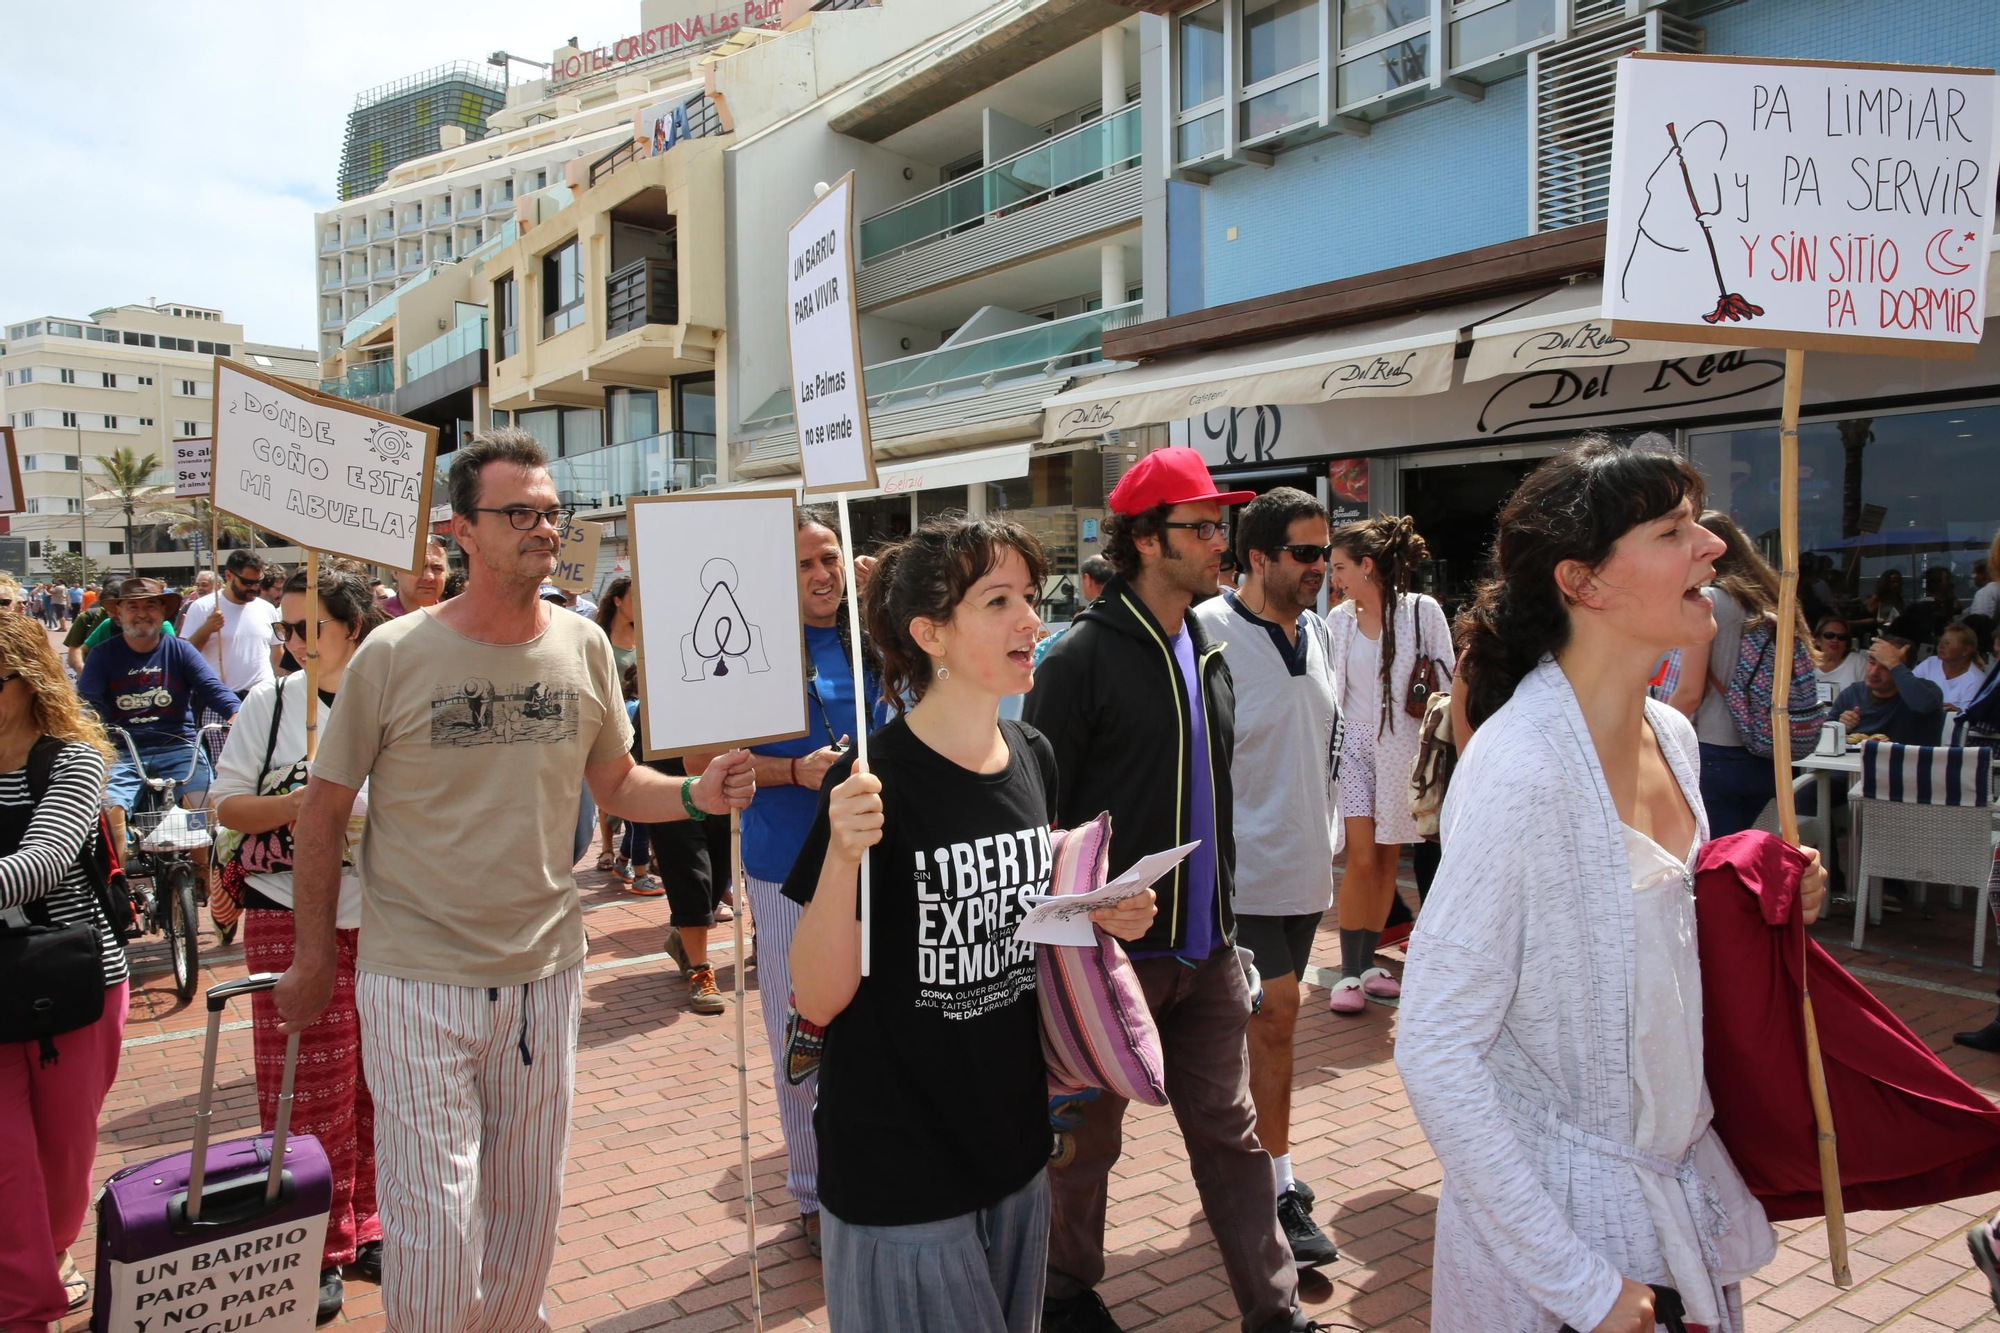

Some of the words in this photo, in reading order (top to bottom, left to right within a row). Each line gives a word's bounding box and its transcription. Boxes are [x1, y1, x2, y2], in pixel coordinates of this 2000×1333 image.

[552, 45, 612, 84] HOTEL
[615, 14, 706, 63] CRISTINA
[710, 11, 738, 34] Las
[744, 0, 784, 24] Palm
[1753, 84, 1792, 132] PA
[1782, 155, 1822, 206] PA
[794, 253, 804, 282] UN
[805, 229, 836, 273] BARRIO
[1739, 234, 1761, 278] Y
[794, 292, 814, 326] PARA
[814, 276, 840, 312] VIVIR
[1827, 289, 1858, 329] PA
[801, 381, 814, 404] Las
[815, 371, 846, 399] Palmas
[1369, 352, 1416, 381] Real
[1188, 389, 1228, 406] Cafeter
[805, 428, 814, 446] no
[815, 425, 825, 444] se
[825, 413, 853, 442] vende
[178, 449, 194, 457] Se
[198, 447, 212, 456] al
[252, 437, 329, 480] COÑO
[179, 471, 196, 480] Se
[913, 871, 931, 881] SIN
[918, 880, 1050, 946] EXPRES
[918, 937, 1037, 986] DEMORA
[915, 998, 939, 1008] SAÚL
[941, 999, 977, 1010] ZAITSEV
[979, 989, 1010, 1005] LESZNO
[920, 989, 953, 1001] GORKA
[955, 985, 986, 1001] OLIVER
[943, 1010, 963, 1020] PIPE
[964, 1006, 984, 1020] DÍAZ
[136, 1260, 178, 1285] UN
[191, 1227, 308, 1271] BARRIO
[135, 1277, 217, 1311] PARA
[228, 1252, 301, 1284] VIVIR
[134, 1316, 153, 1333] Y
[163, 1303, 209, 1327] NO
[220, 1278, 295, 1312] PARA
